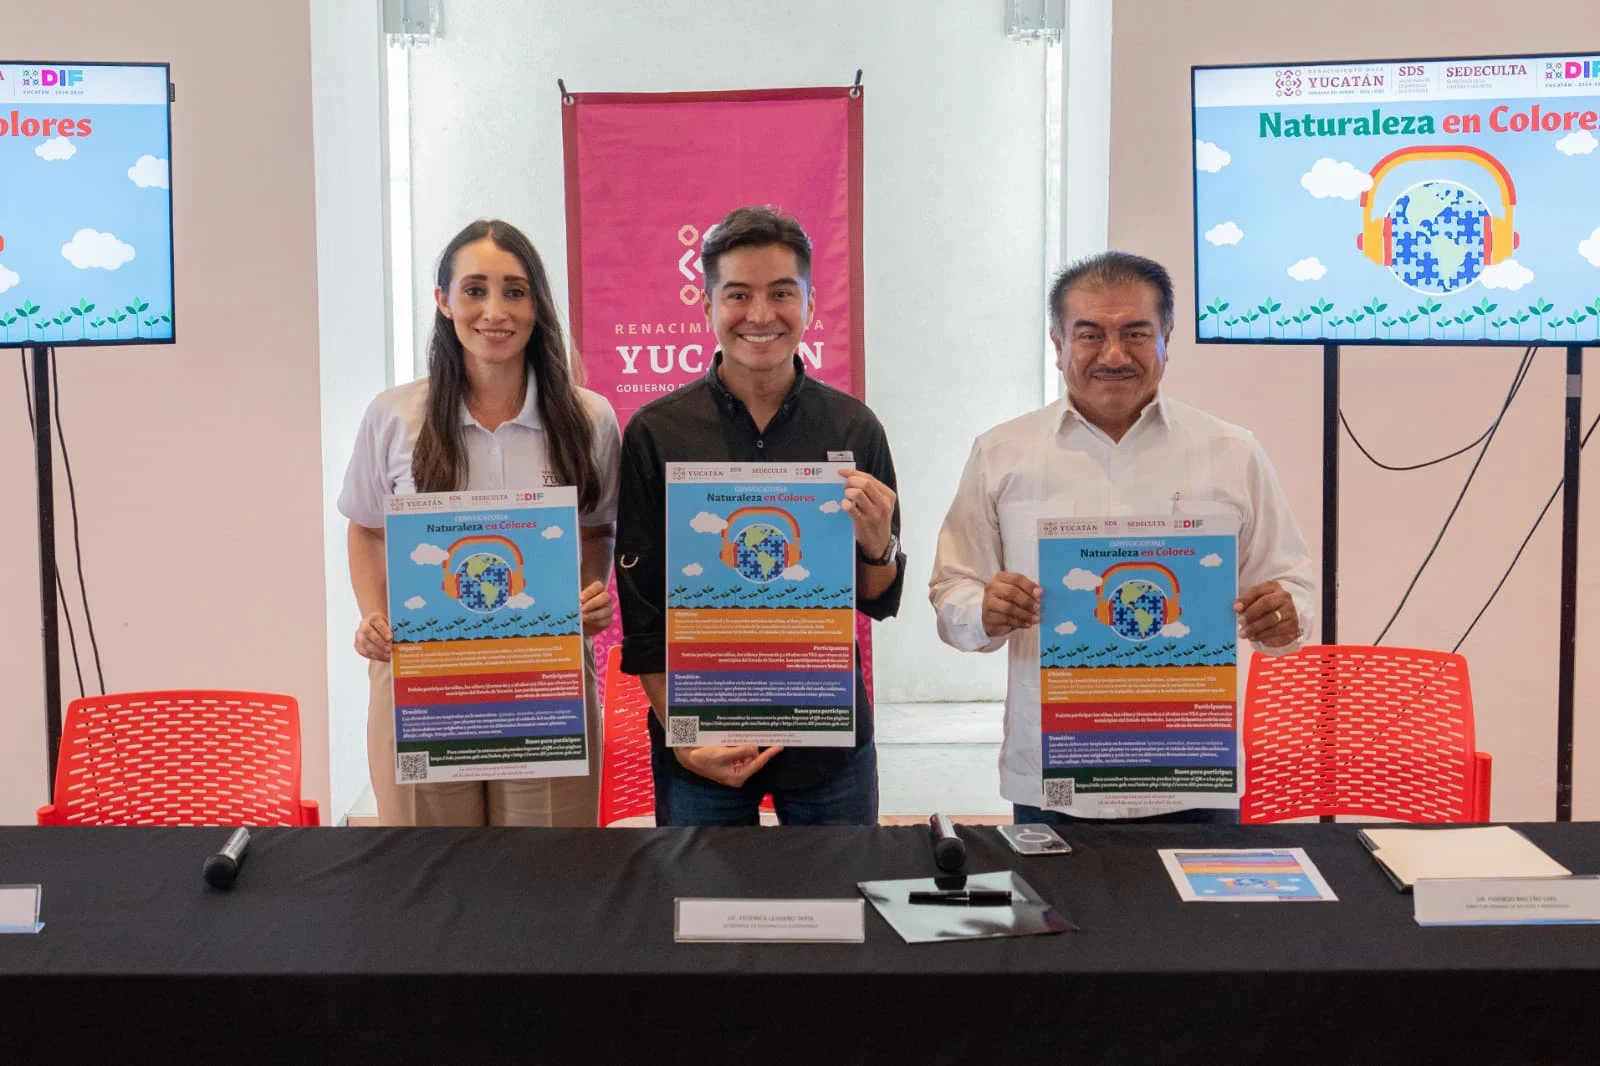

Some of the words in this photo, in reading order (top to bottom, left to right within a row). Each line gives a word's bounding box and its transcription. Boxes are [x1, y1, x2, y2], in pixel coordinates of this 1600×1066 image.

[1399, 66, 1425, 77] SDS
[1446, 64, 1527, 78] SEDECULTA
[42, 70, 83, 86] DIF
[1308, 74, 1384, 89] YUCATÁN
[1260, 109, 1435, 137] Naturaleza
[1442, 113, 1481, 134] en
[1489, 104, 1600, 132] Colore
[616, 383, 676, 394] GOBIERNO
[804, 467, 824, 476] DIF
[524, 492, 544, 502] DIF
[707, 493, 762, 503] Naturaleza
[764, 495, 776, 503] en
[778, 493, 816, 503] Colores
[426, 522, 483, 533] Naturaleza
[499, 520, 537, 530] Colores
[1182, 519, 1204, 529] DIF
[1080, 549, 1138, 558] Naturaleza
[1155, 547, 1194, 557] Colores
